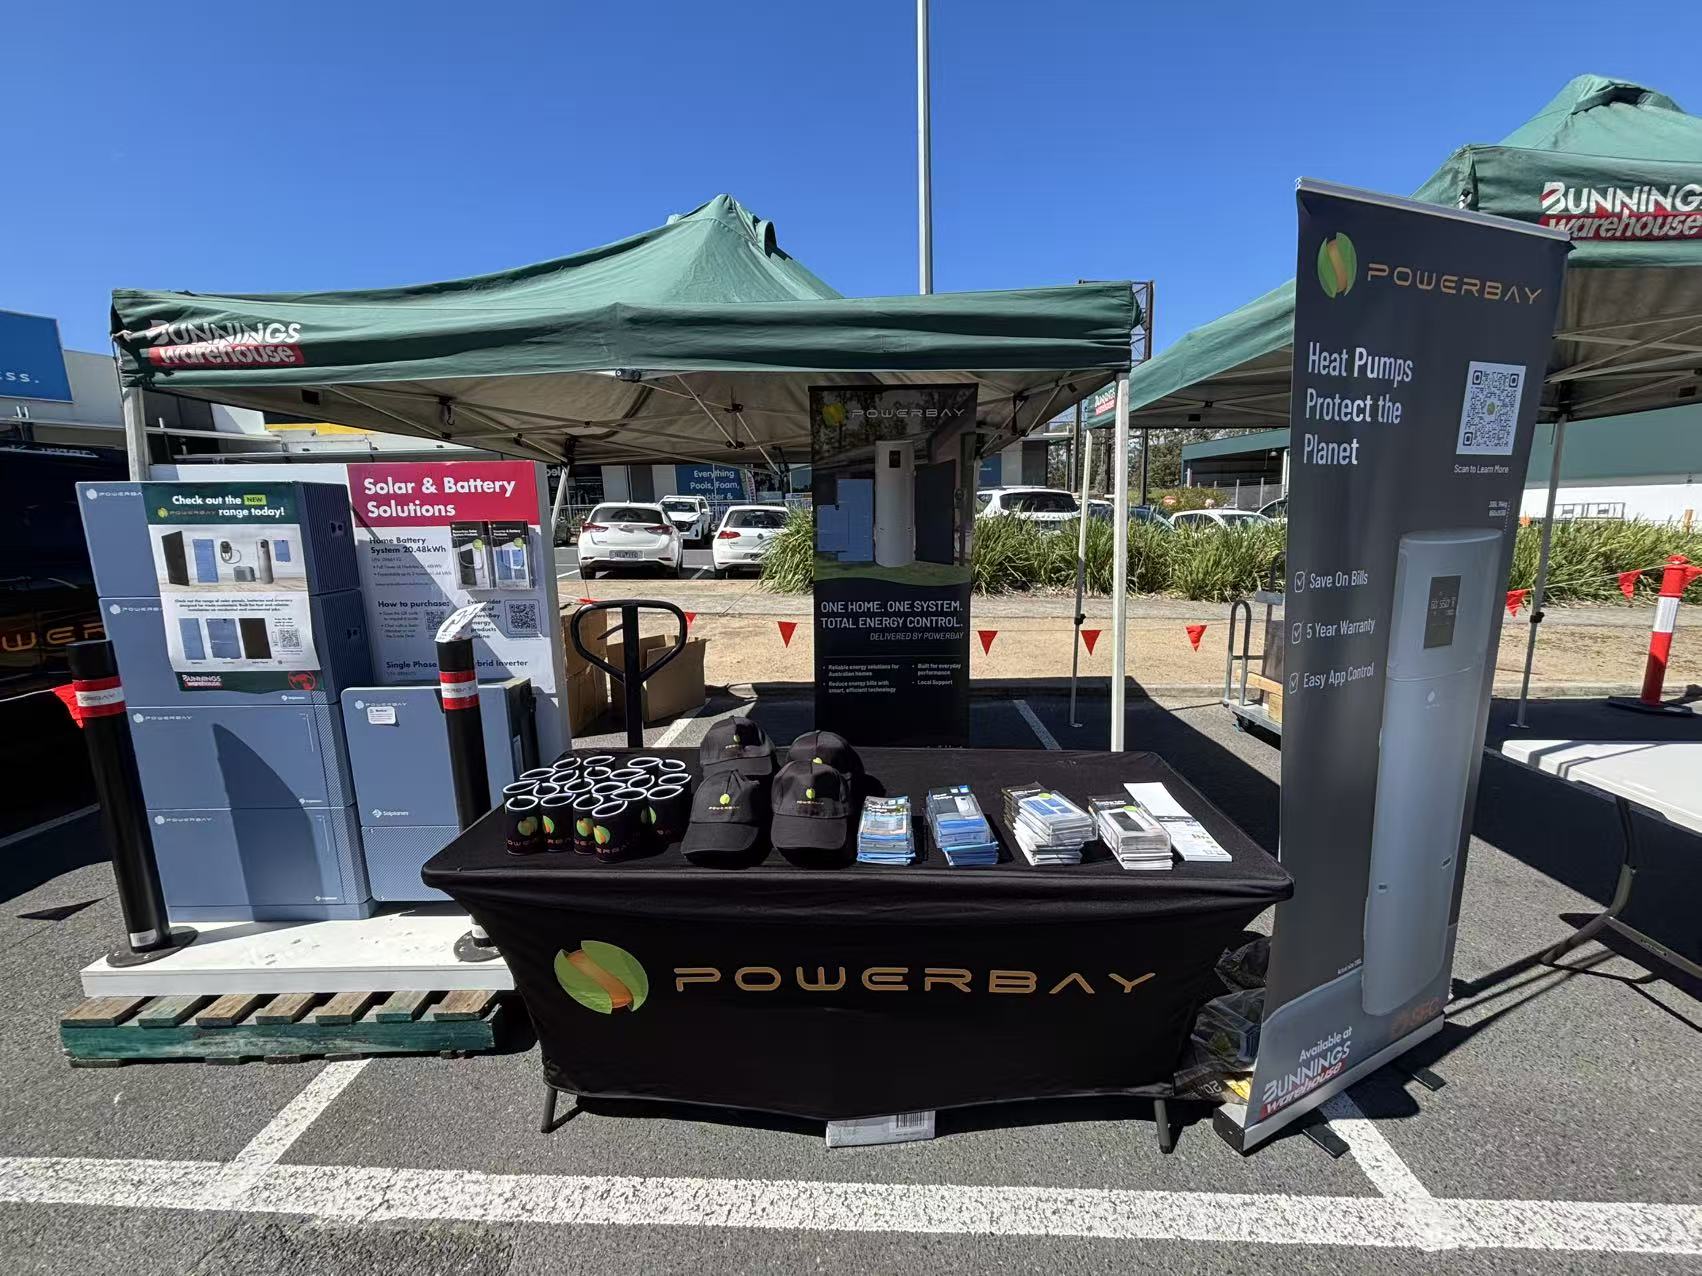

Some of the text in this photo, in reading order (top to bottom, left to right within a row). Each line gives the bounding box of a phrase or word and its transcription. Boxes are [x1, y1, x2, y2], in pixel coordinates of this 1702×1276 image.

[1540, 182, 1702, 214] BUNNING
[1548, 207, 1702, 237] warehouse
[1367, 263, 1542, 305] POWERBAY
[146, 319, 301, 346] BUNNINGS
[160, 344, 296, 363] warehouse
[1308, 341, 1413, 388] Heat Pumps
[0, 371, 39, 384] SS.
[852, 407, 966, 418] POWERBAY
[1305, 388, 1403, 425] Protect the
[1303, 433, 1360, 466] Planet
[1454, 464, 1470, 473] Scan
[1477, 465, 1494, 474] Learn
[1494, 465, 1509, 474] More
[364, 477, 516, 497] Solar & Battery
[690, 481, 740, 490] Pools, Foam,
[172, 495, 204, 505] Check
[205, 496, 224, 505] out
[224, 495, 242, 505] the
[367, 500, 456, 518] Solutions
[218, 508, 249, 518] range
[250, 507, 285, 518] today!
[371, 545, 447, 555] System 20.48kWh
[396, 536, 426, 545] Battery
[1309, 569, 1368, 589] Save On Bills
[410, 600, 450, 609] purchase:
[820, 600, 963, 612] ONE HOME. ONE SYSTEM.
[820, 616, 963, 628] TOTAL ENERGY CONTROL.
[1306, 618, 1376, 638] 5 Year Warranty
[870, 632, 964, 640] DELIVERED BY POWERBAY
[386, 661, 411, 669] Single
[1303, 662, 1374, 690] Easy App Control
[674, 965, 1157, 994] POWERBAY
[1299, 1026, 1352, 1063] Available at
[1262, 1041, 1351, 1105] BUNNINGS
